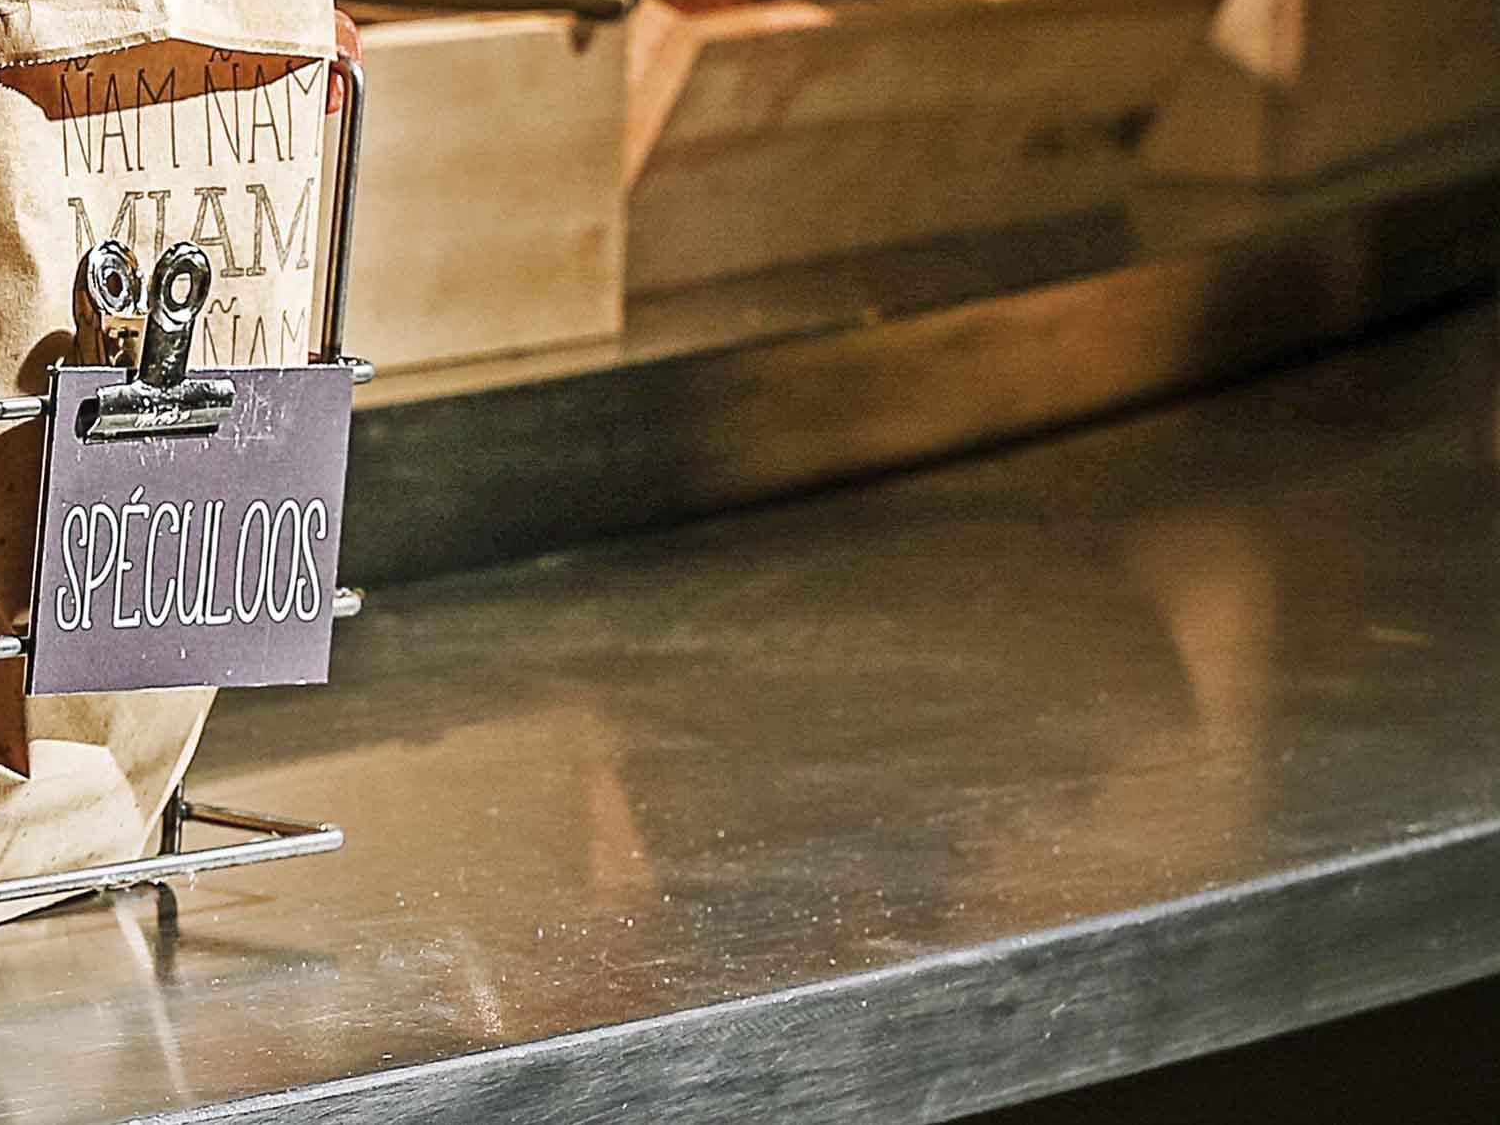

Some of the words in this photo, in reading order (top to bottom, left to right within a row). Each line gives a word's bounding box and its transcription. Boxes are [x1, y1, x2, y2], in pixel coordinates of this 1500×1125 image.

[59, 53, 180, 176] ÑAM
[203, 47, 323, 168] ÑAM
[67, 177, 315, 278] MIAM
[55, 485, 328, 632] SPÉCULOOS
